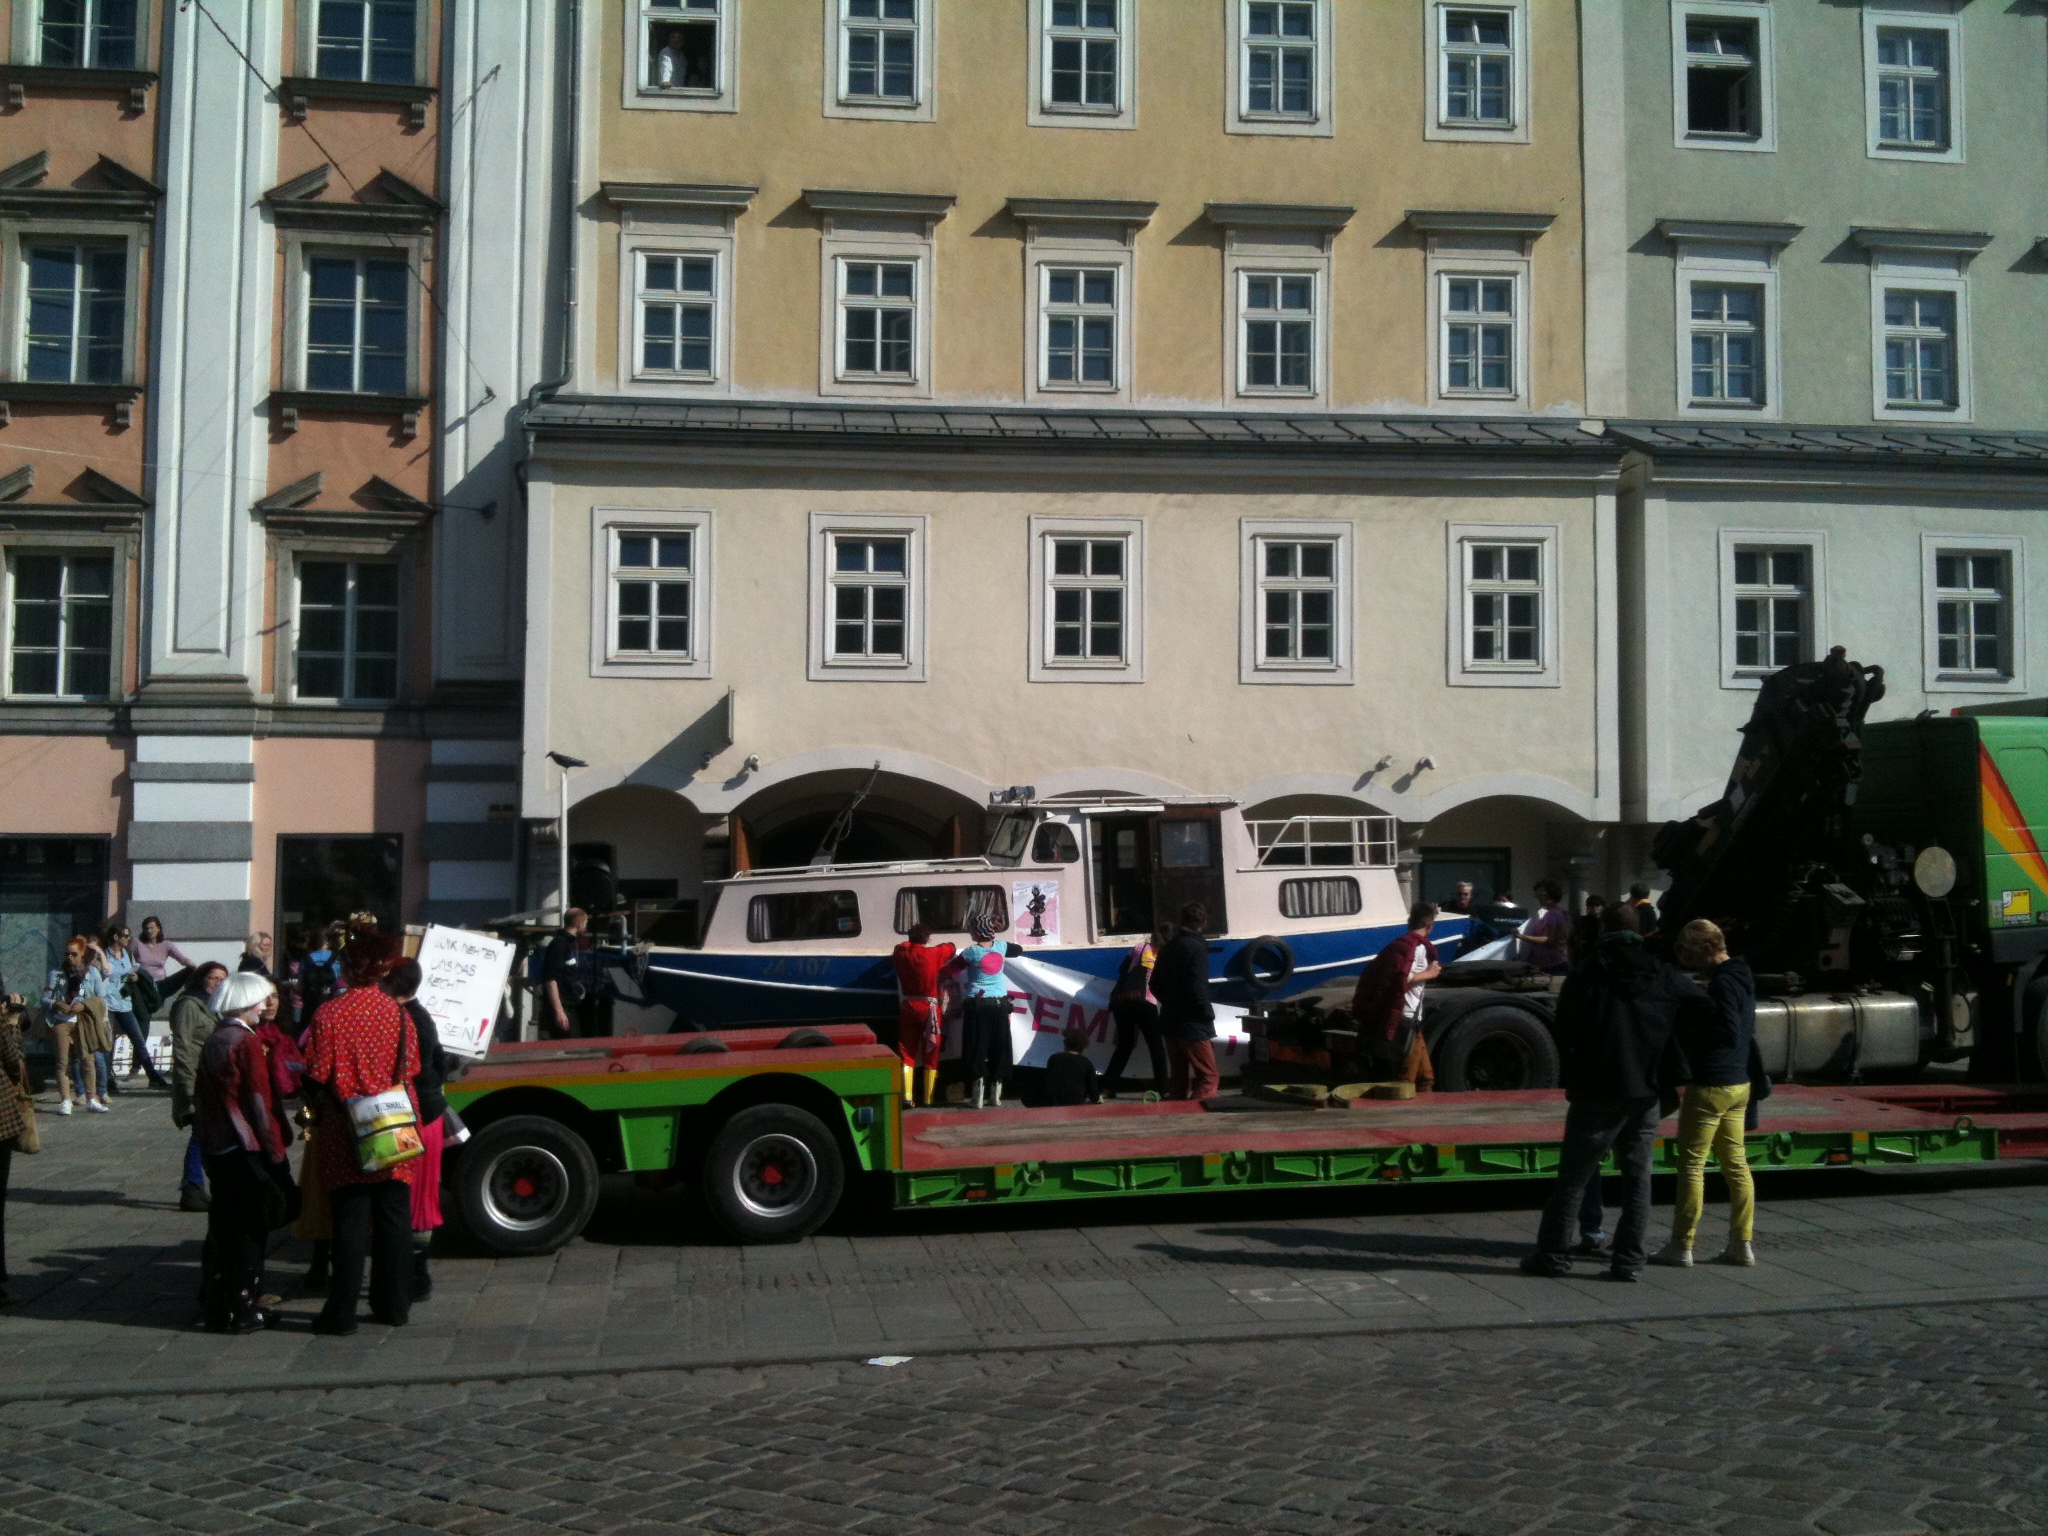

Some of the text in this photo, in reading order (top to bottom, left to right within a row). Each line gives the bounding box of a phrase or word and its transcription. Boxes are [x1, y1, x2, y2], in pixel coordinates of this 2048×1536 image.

[434, 937, 458, 952] WIR
[431, 958, 478, 977] UNS DAS
[426, 973, 467, 991] RECHT
